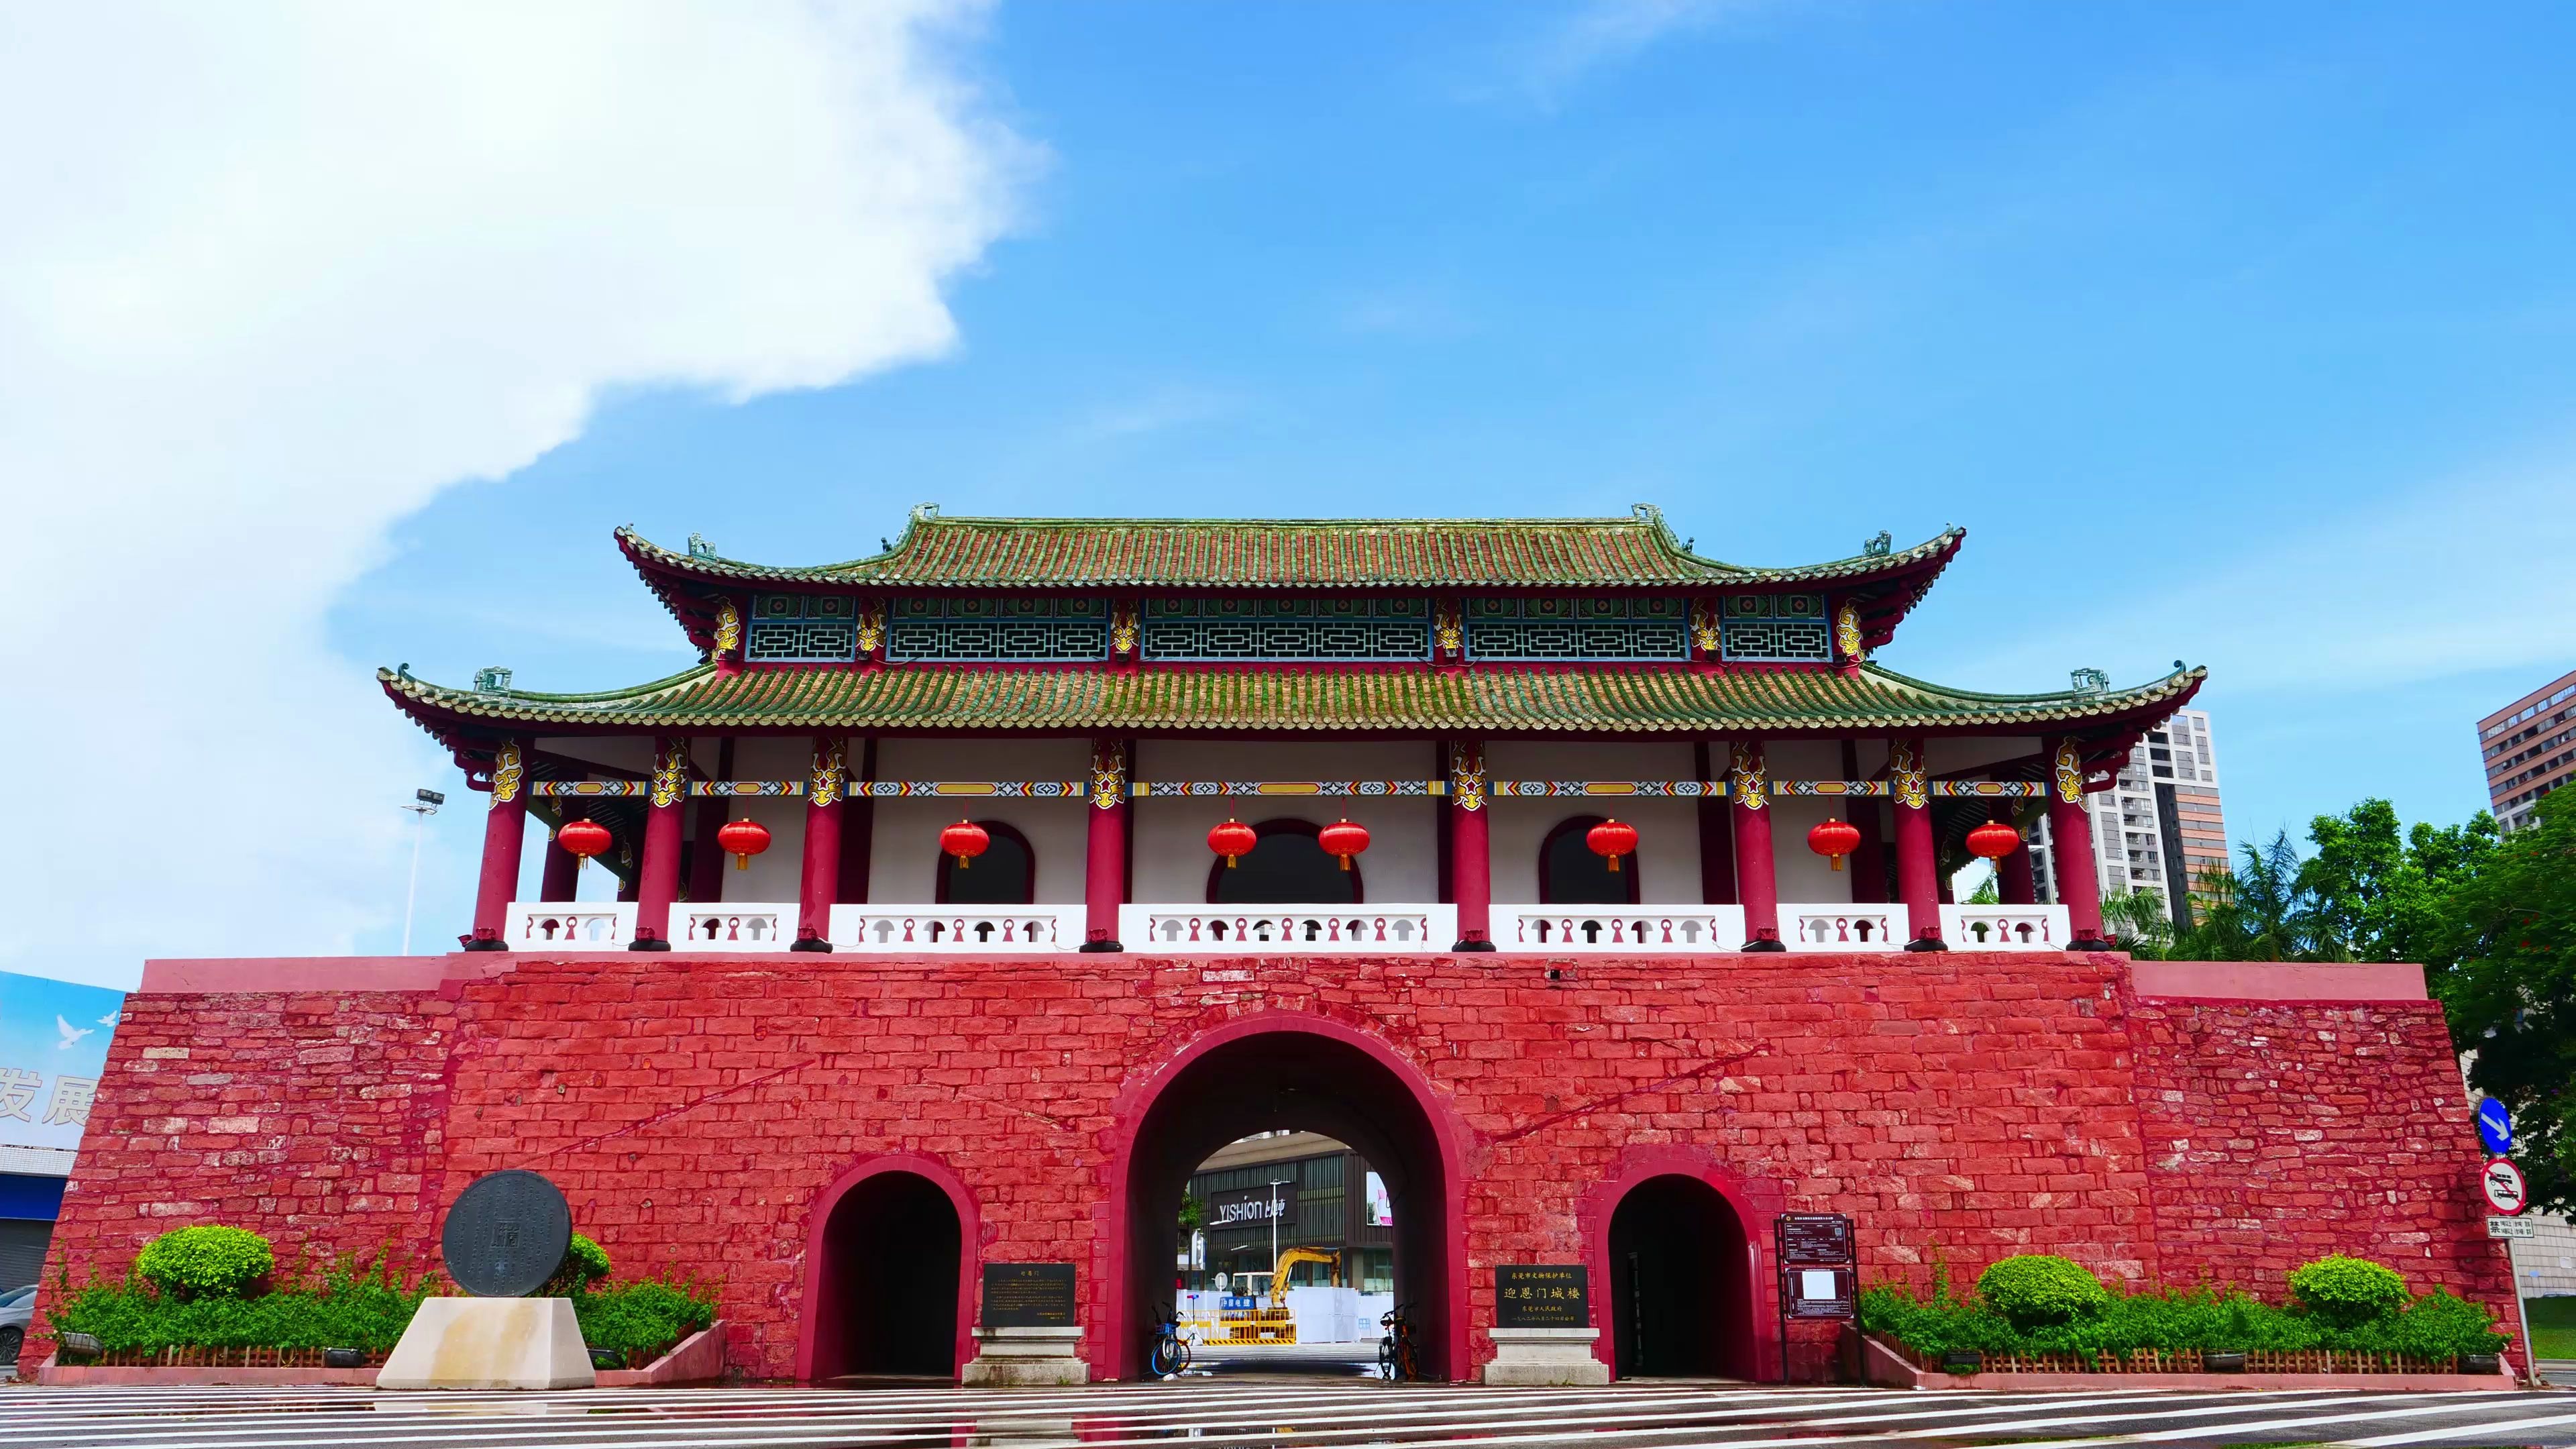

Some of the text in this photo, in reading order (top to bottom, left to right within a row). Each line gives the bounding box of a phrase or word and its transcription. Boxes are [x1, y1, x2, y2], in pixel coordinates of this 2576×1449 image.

[0, 1068, 99, 1127] 发展
[2489, 1221, 2501, 1233] 禁
[1504, 1287, 1580, 1299] 迎恩门城楼
